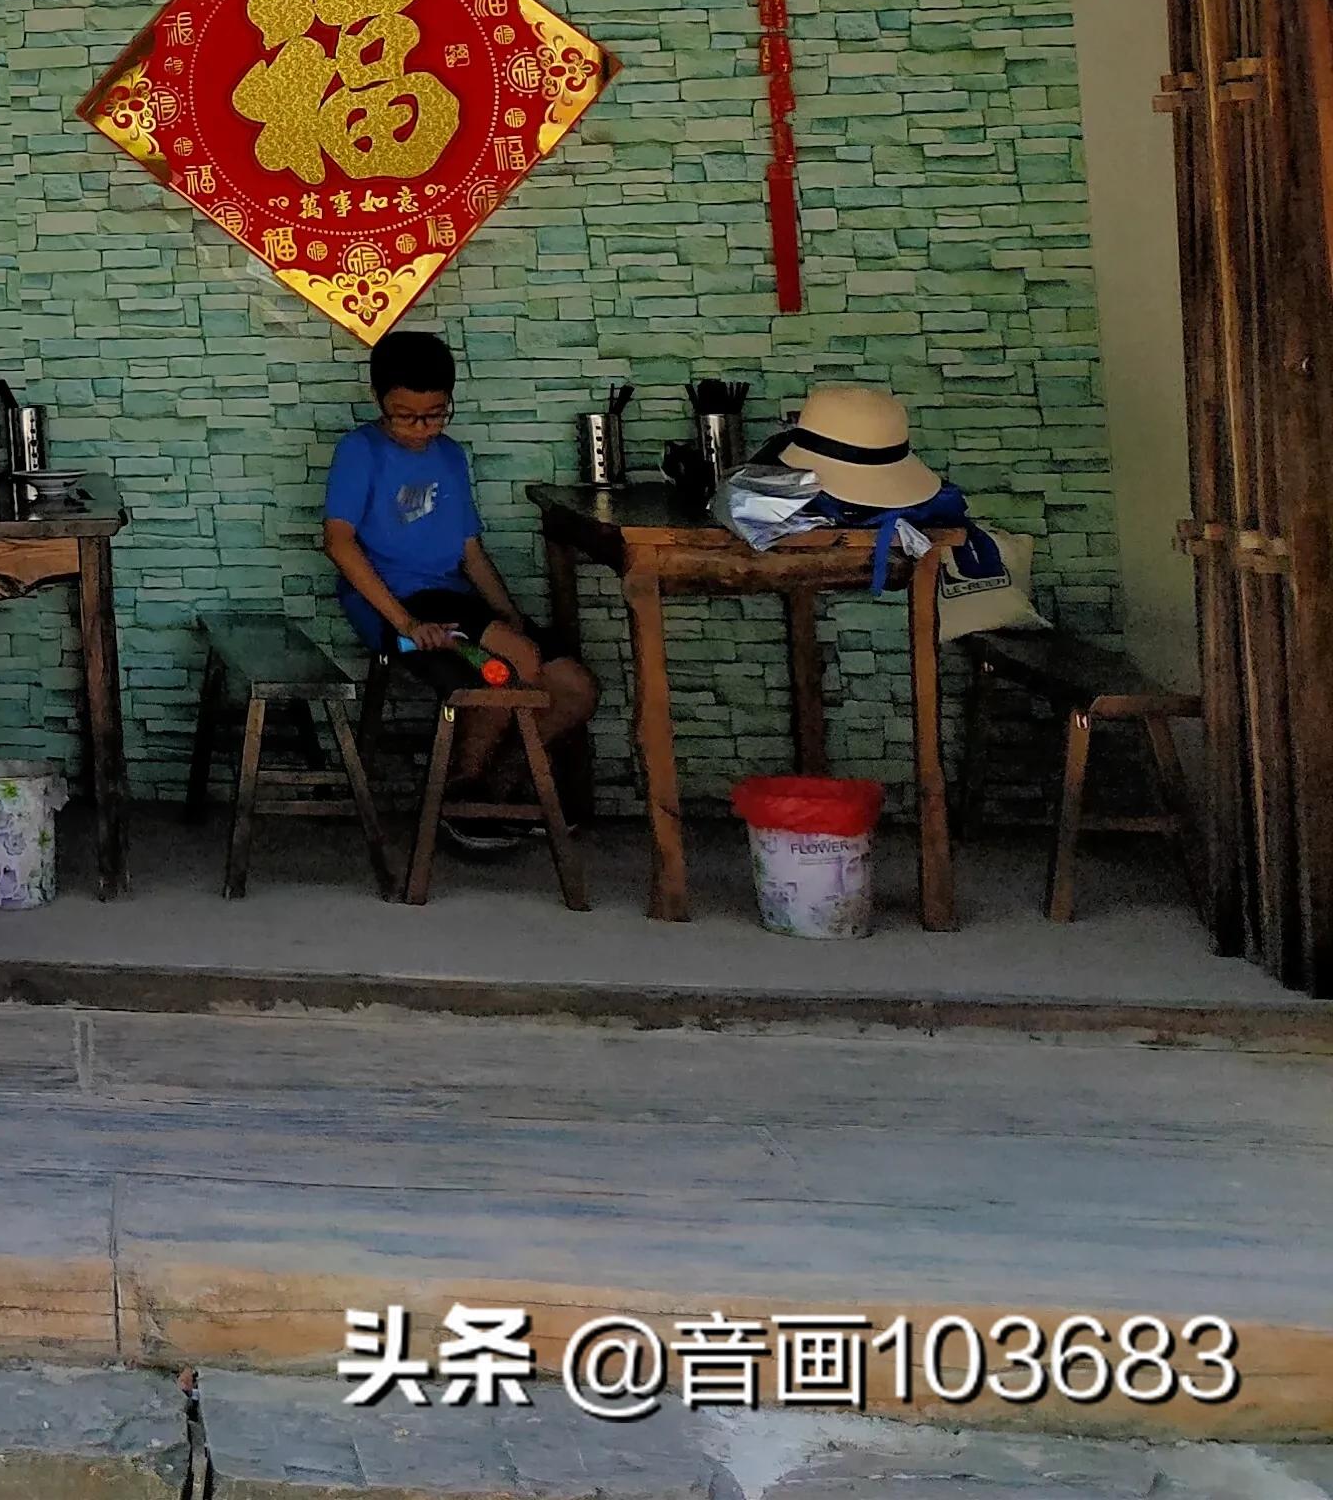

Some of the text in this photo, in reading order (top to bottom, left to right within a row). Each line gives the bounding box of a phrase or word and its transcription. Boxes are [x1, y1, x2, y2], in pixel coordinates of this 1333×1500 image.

[299, 185, 420, 220] 萬事如意
[791, 840, 849, 854] FLOWER
